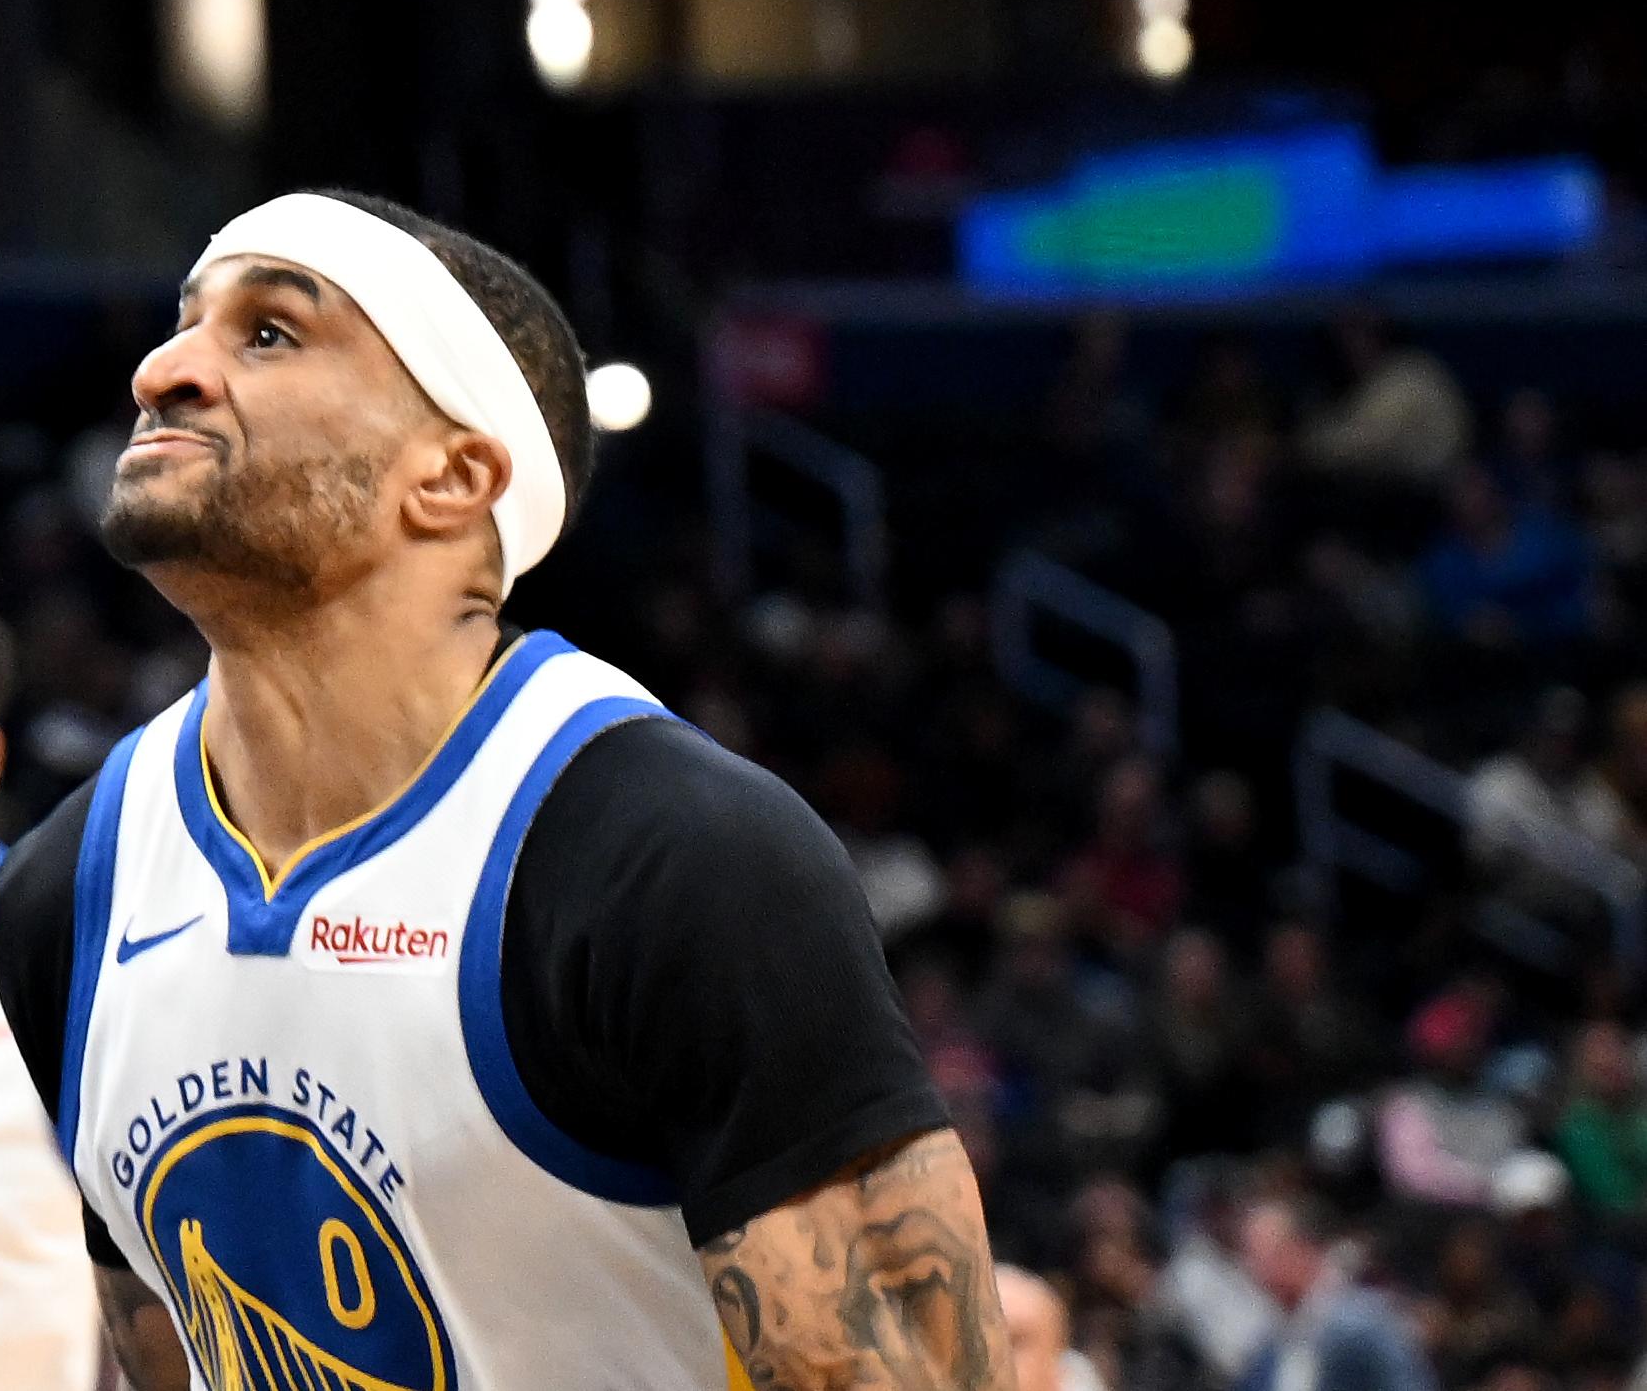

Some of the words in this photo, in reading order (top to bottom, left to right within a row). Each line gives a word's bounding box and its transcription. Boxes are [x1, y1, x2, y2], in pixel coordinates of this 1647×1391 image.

[310, 915, 449, 960] Rakuten
[112, 1056, 270, 1191] GOLDEN
[292, 1068, 405, 1206] STATE
[318, 1217, 377, 1331] 0
